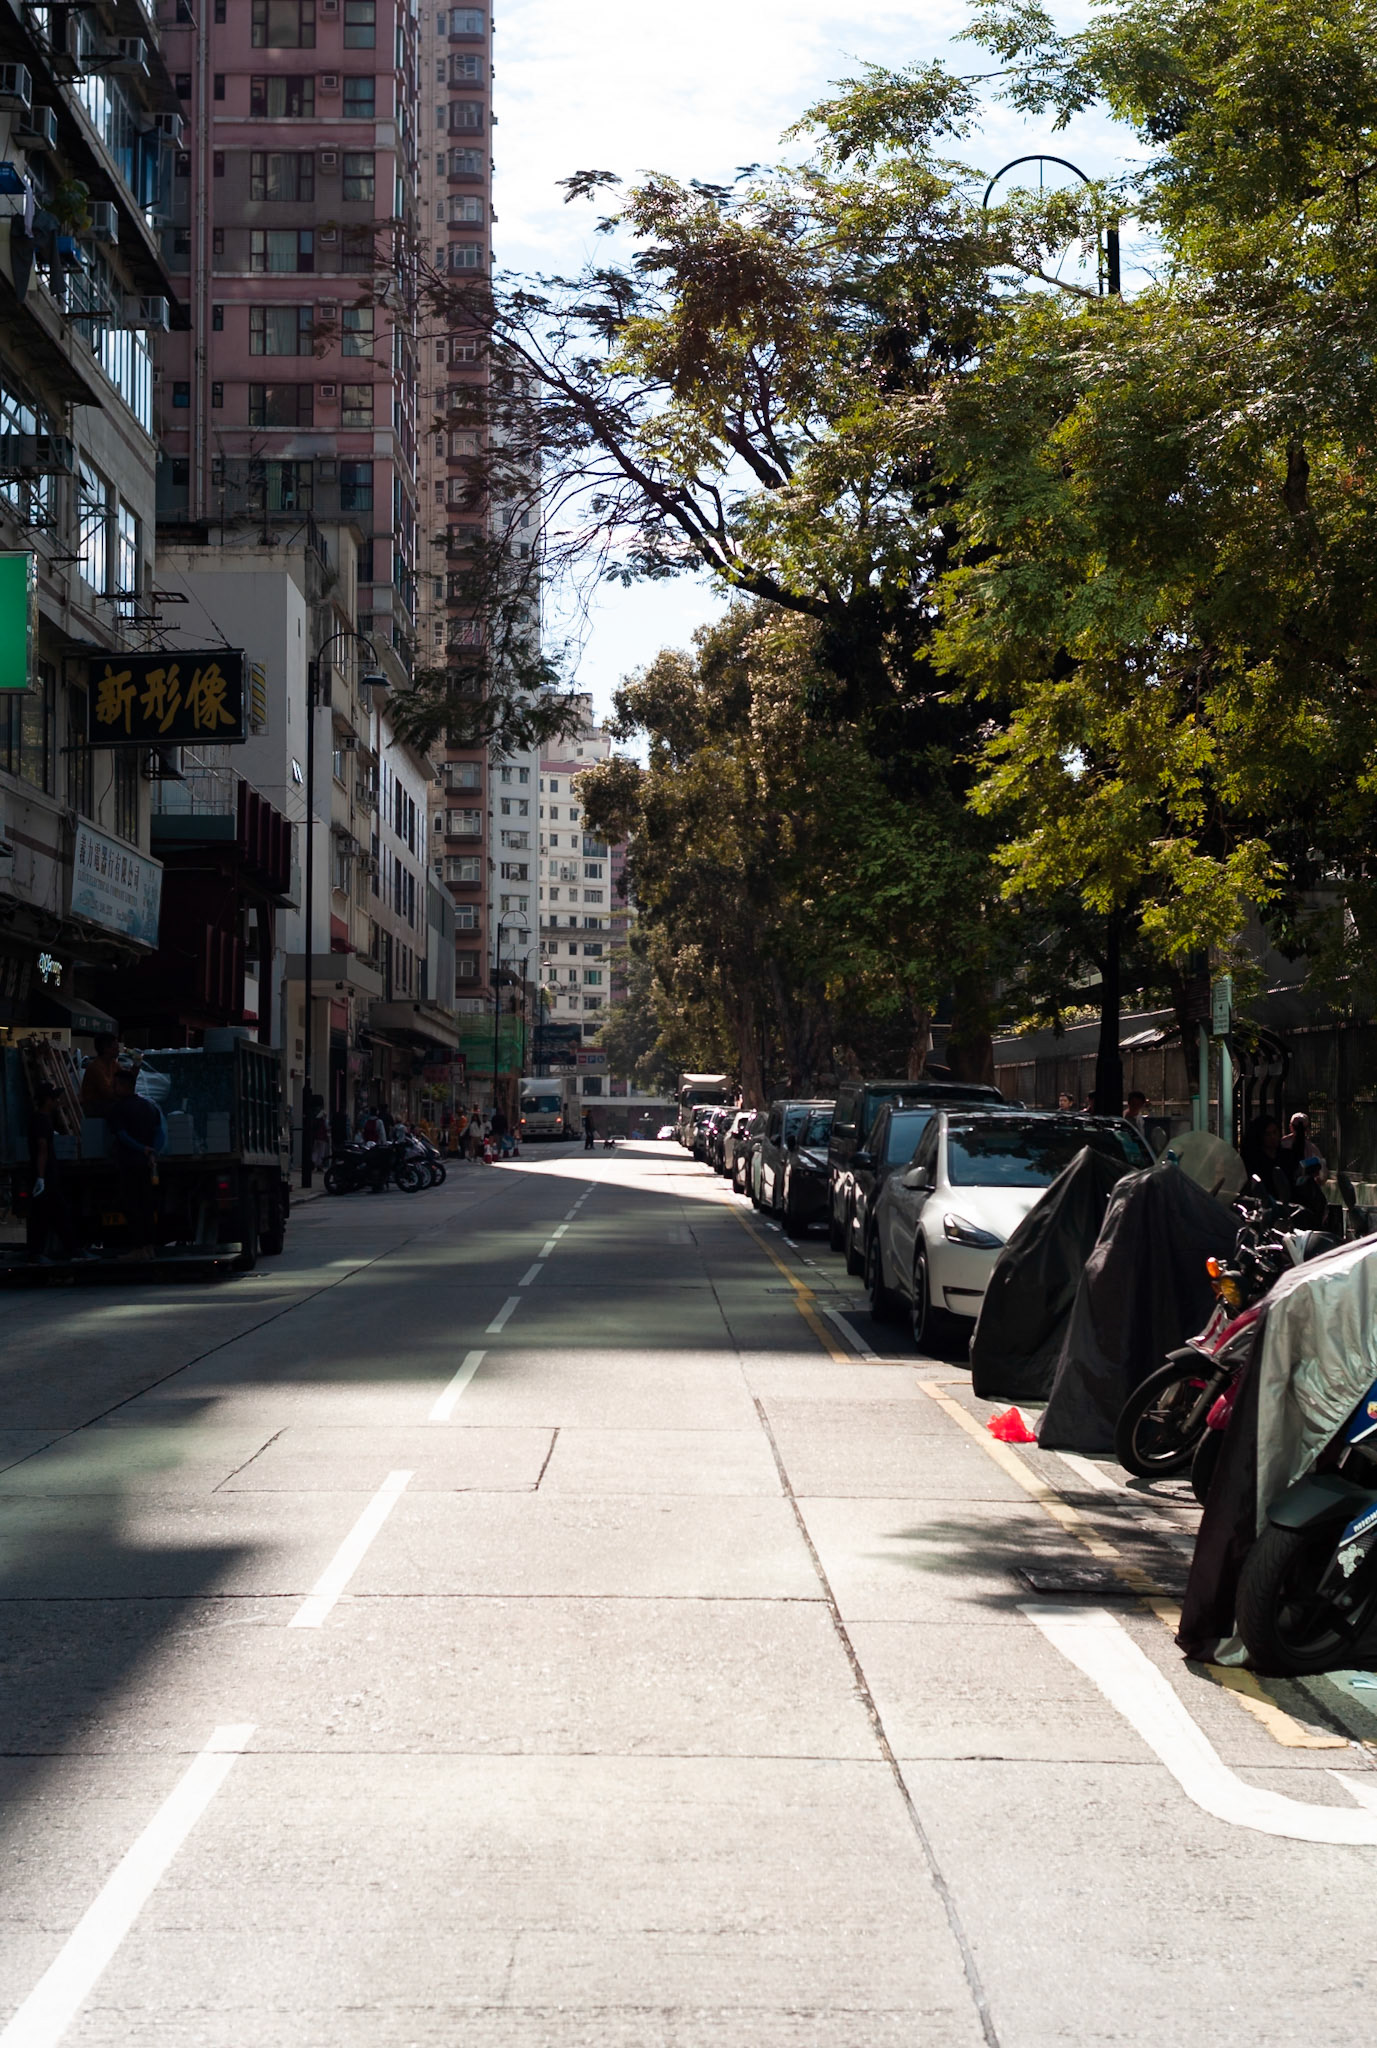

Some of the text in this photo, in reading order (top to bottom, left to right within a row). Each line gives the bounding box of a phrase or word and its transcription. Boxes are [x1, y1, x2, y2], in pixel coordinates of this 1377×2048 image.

[96, 664, 235, 734] 新形像
[1353, 1510, 1377, 1533] MICH
